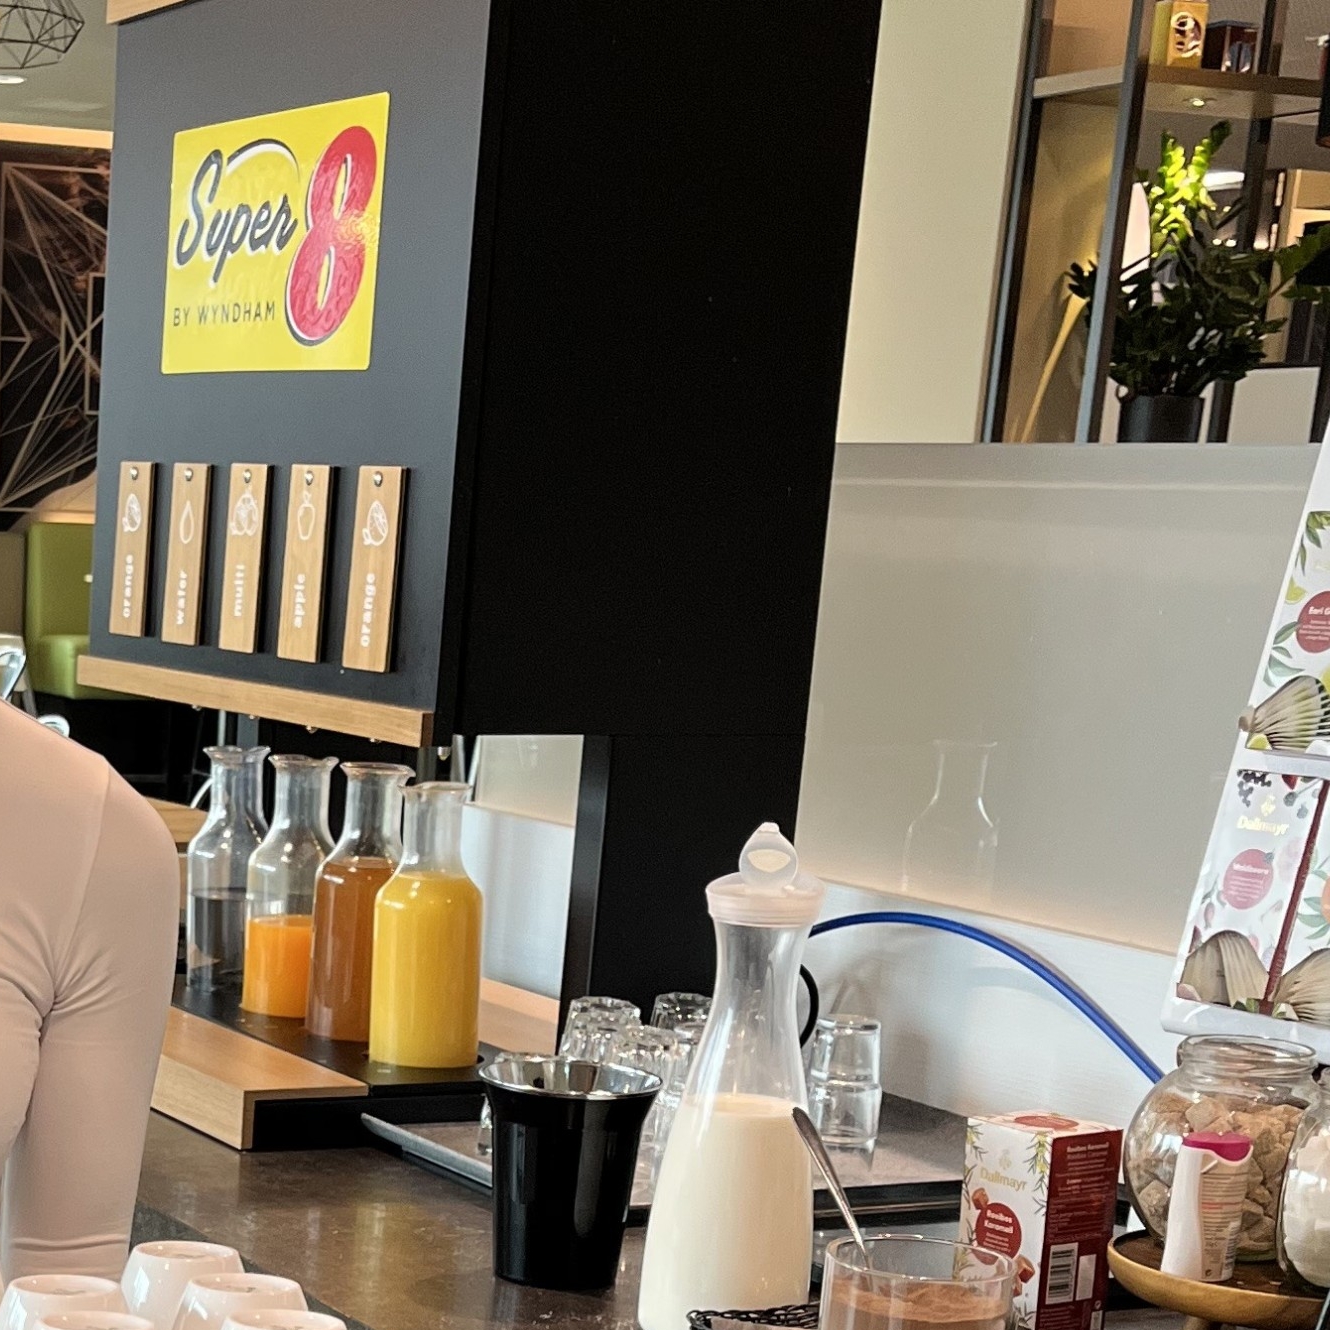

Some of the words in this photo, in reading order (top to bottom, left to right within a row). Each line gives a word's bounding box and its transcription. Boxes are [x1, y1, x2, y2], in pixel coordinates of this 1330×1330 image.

[175, 149, 298, 288] Super
[285, 125, 377, 346] 8
[173, 307, 191, 327] BY
[198, 301, 276, 324] WYNDHAM
[123, 554, 134, 618] orange
[176, 570, 187, 625] water
[234, 564, 245, 616] multi
[293, 573, 306, 628] apple
[360, 572, 376, 648] orange
[980, 1167, 1027, 1192] Dallmayr
